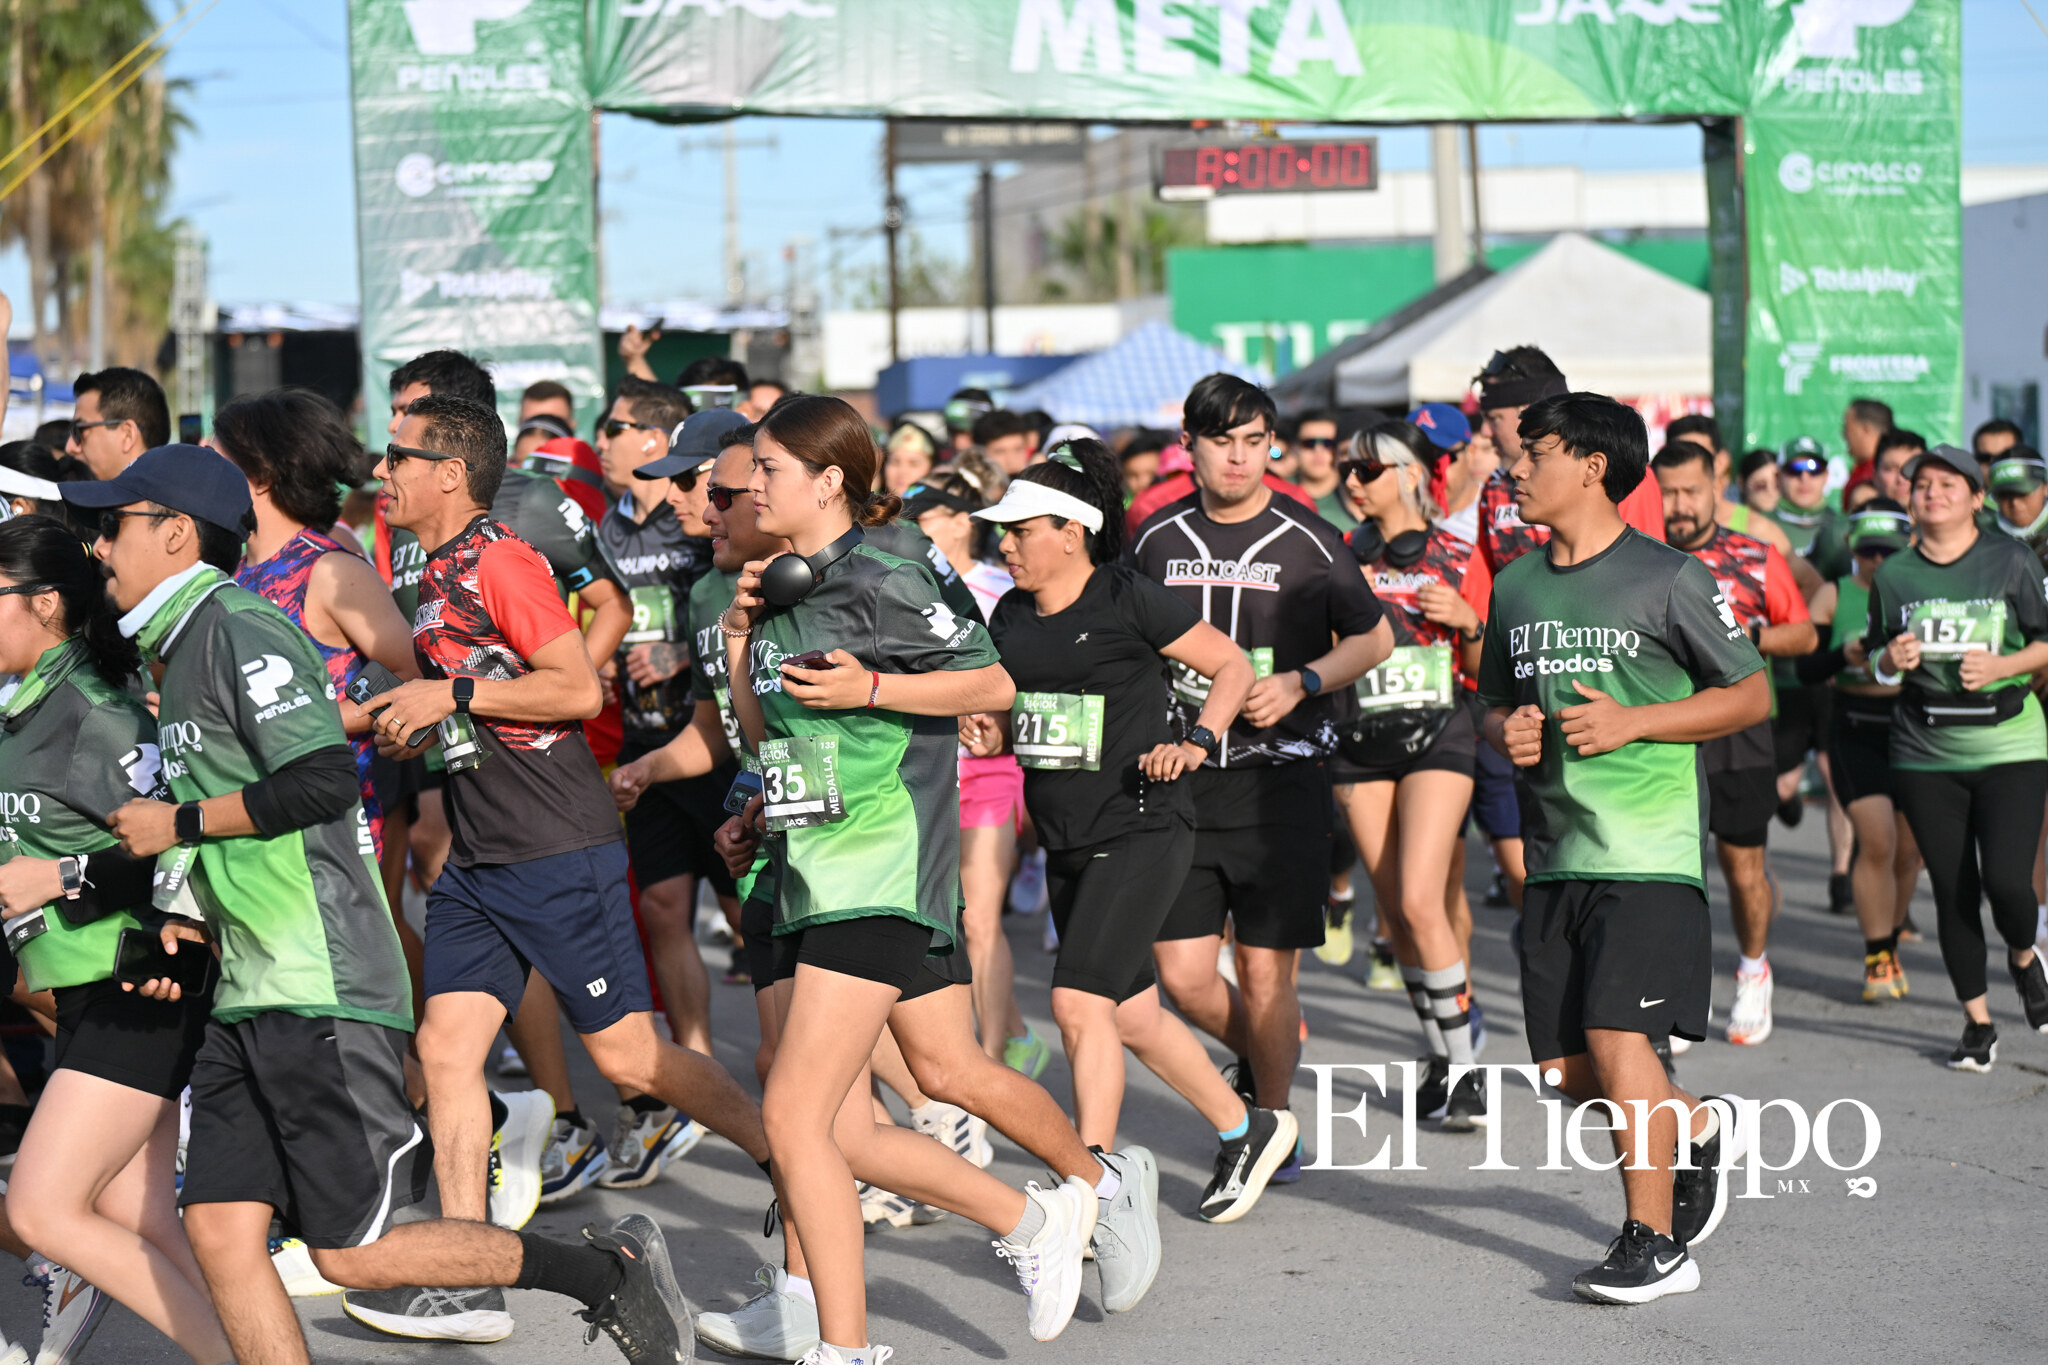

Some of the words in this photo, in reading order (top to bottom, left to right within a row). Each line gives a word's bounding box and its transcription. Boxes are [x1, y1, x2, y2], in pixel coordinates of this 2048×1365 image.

[1009, 0, 1364, 76] META
[1165, 560, 1281, 584] IRONCAST
[1509, 623, 1531, 657] El
[1535, 620, 1640, 657] Tiempo
[1920, 618, 1977, 643] 157
[1366, 664, 1425, 696] 159
[1514, 660, 1535, 679] de
[1537, 654, 1614, 675] todos
[1017, 712, 1068, 745] 215
[820, 741, 835, 749] 135
[823, 755, 841, 814] MEDALLA
[167, 847, 194, 891] MEDAL
